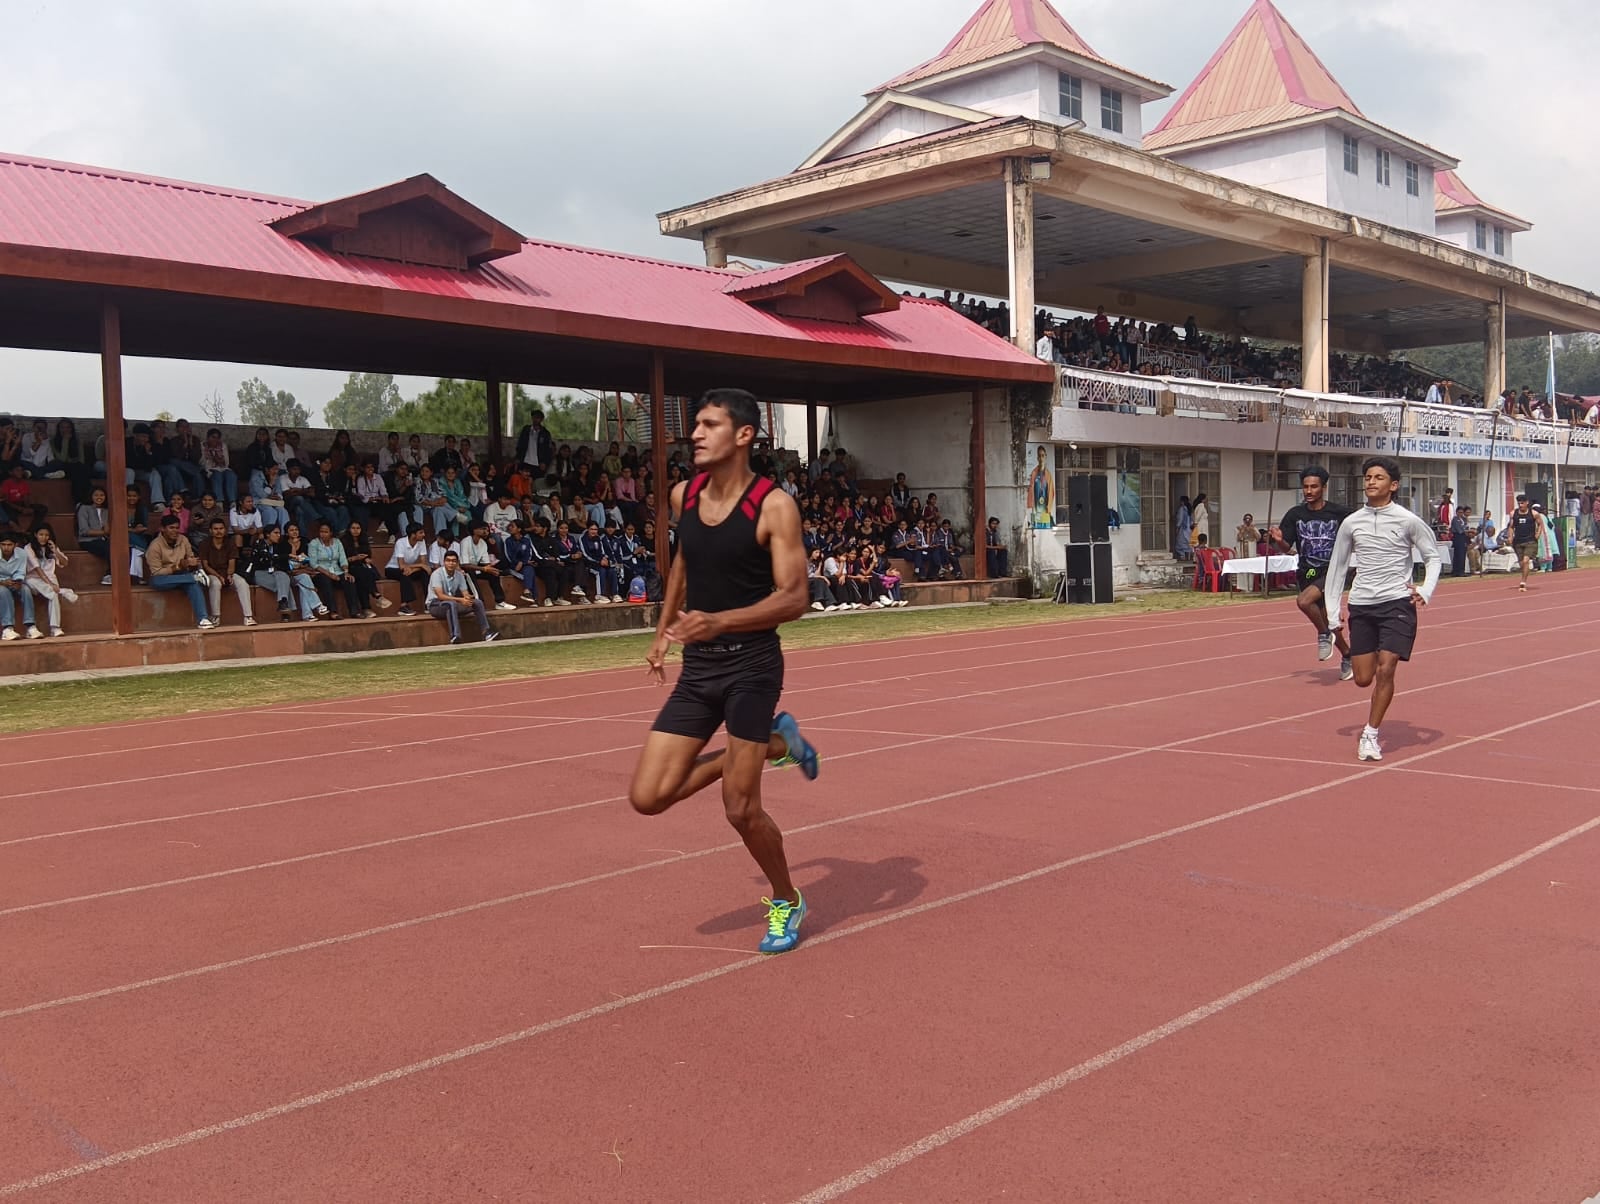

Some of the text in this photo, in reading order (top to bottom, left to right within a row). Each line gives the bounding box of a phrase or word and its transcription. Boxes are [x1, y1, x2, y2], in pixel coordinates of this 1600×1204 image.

[1311, 432, 1371, 449] DEPARTMENT
[1376, 436, 1387, 450] OF
[1391, 437, 1417, 452] YOUTH
[1419, 440, 1451, 454] SERVICES
[1459, 443, 1482, 456] SPORTS
[1494, 445, 1523, 458] SYNTHETIC
